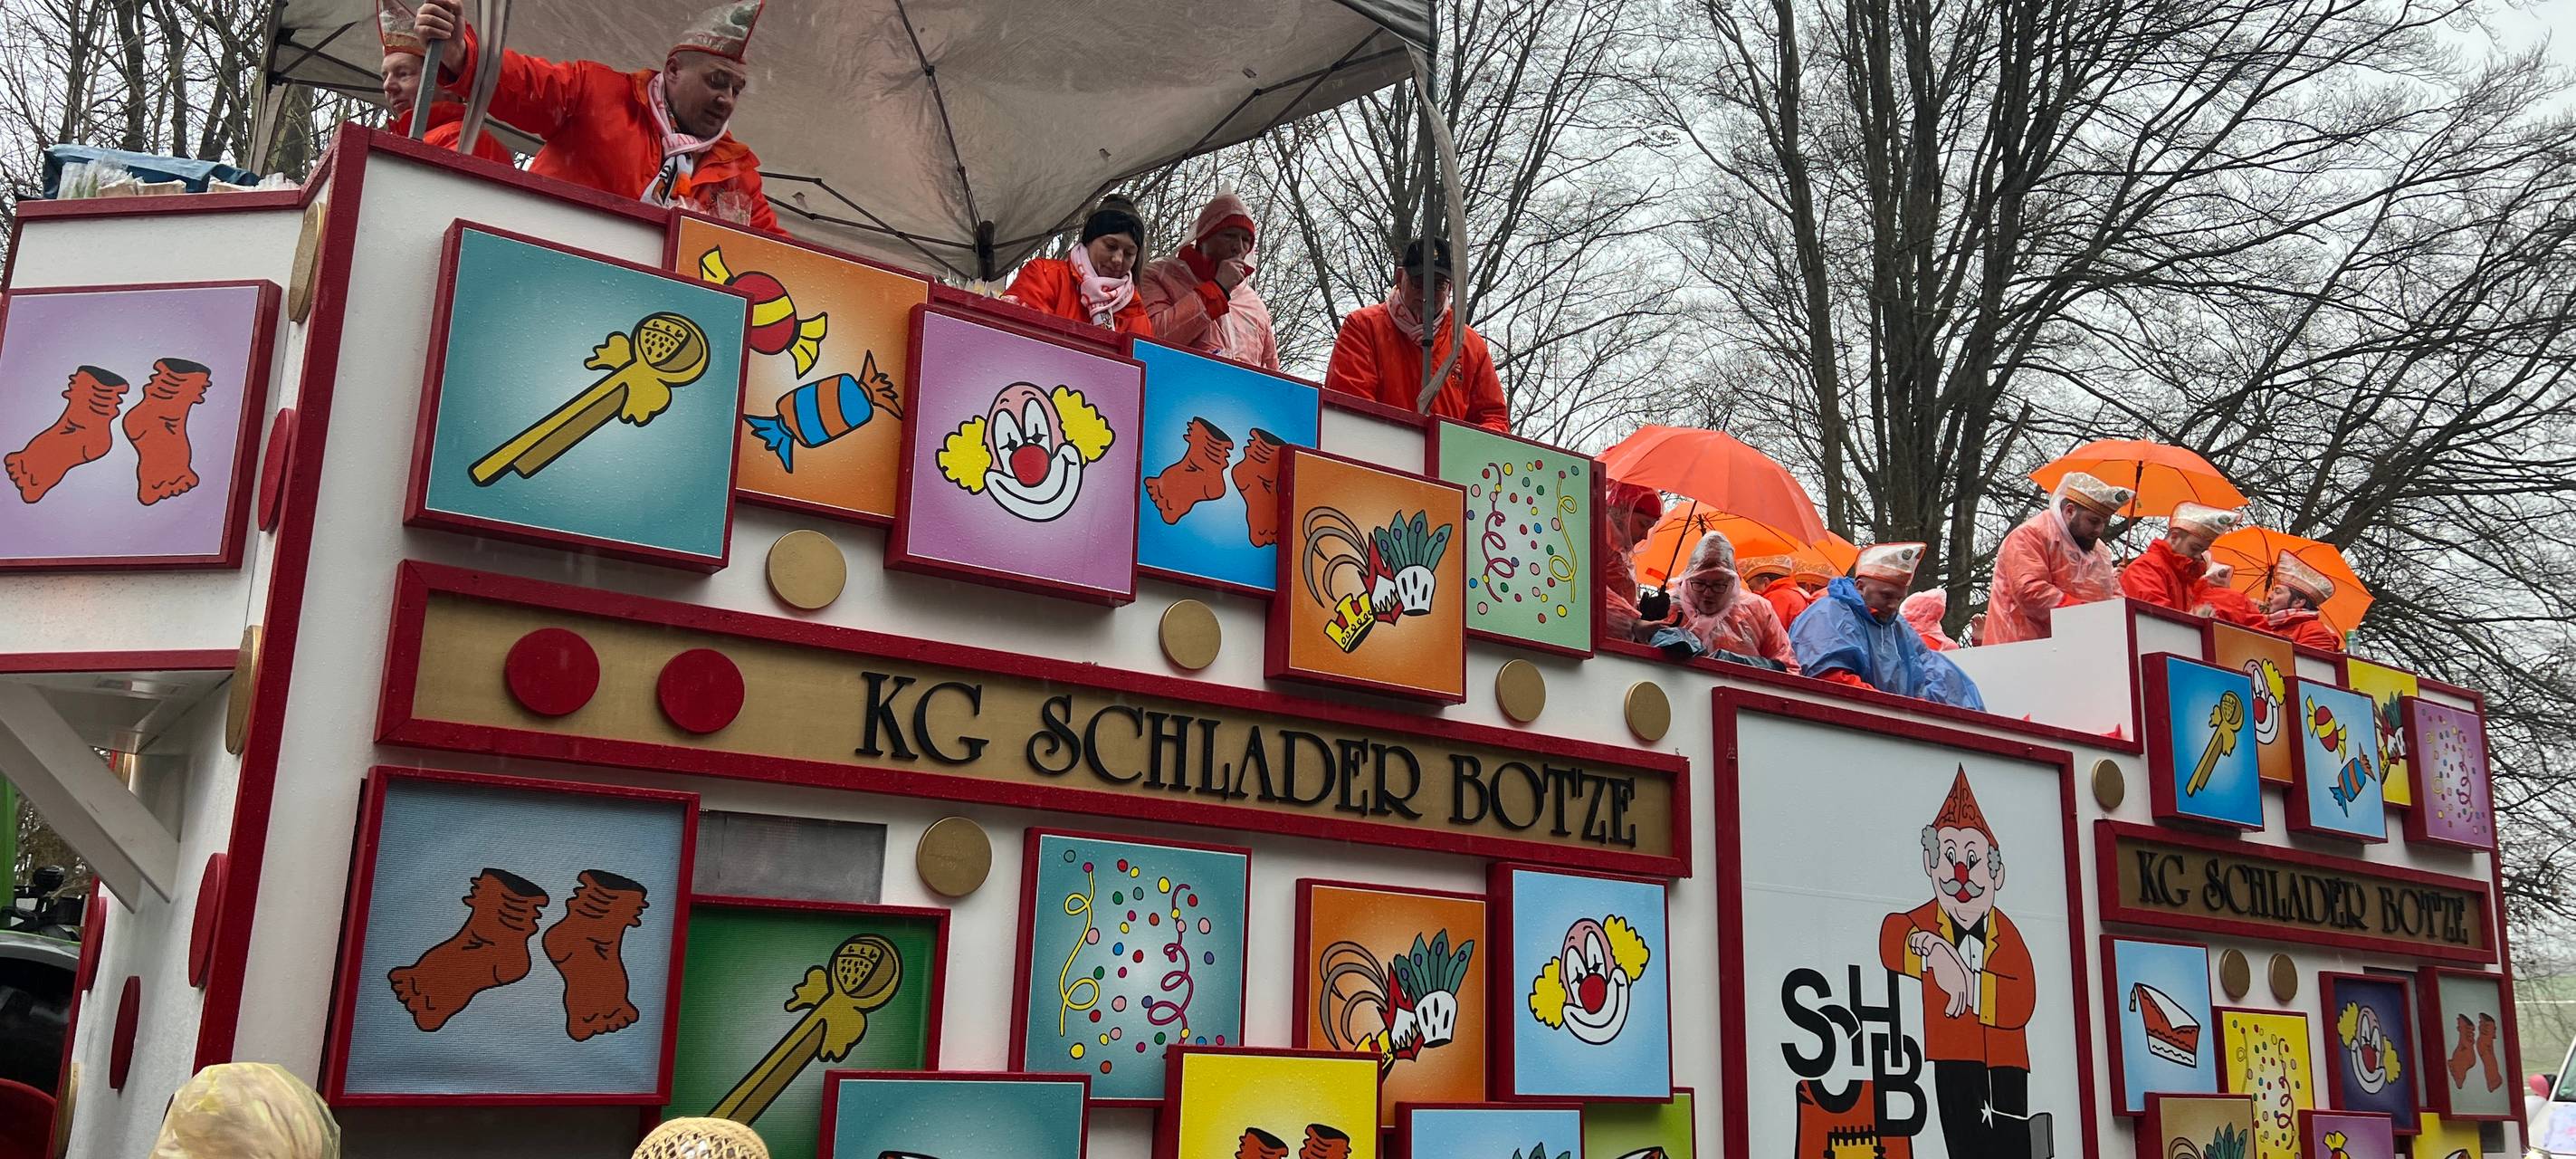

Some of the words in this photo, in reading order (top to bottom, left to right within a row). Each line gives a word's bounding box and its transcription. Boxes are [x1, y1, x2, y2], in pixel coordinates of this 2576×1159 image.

[854, 671, 991, 765] KG
[1026, 694, 1423, 820] SCHLADER
[1450, 753, 1637, 848] BOTZE
[2137, 849, 2190, 907] KG
[2202, 857, 2369, 931] SCHLADER
[2377, 886, 2469, 945] BOTZE
